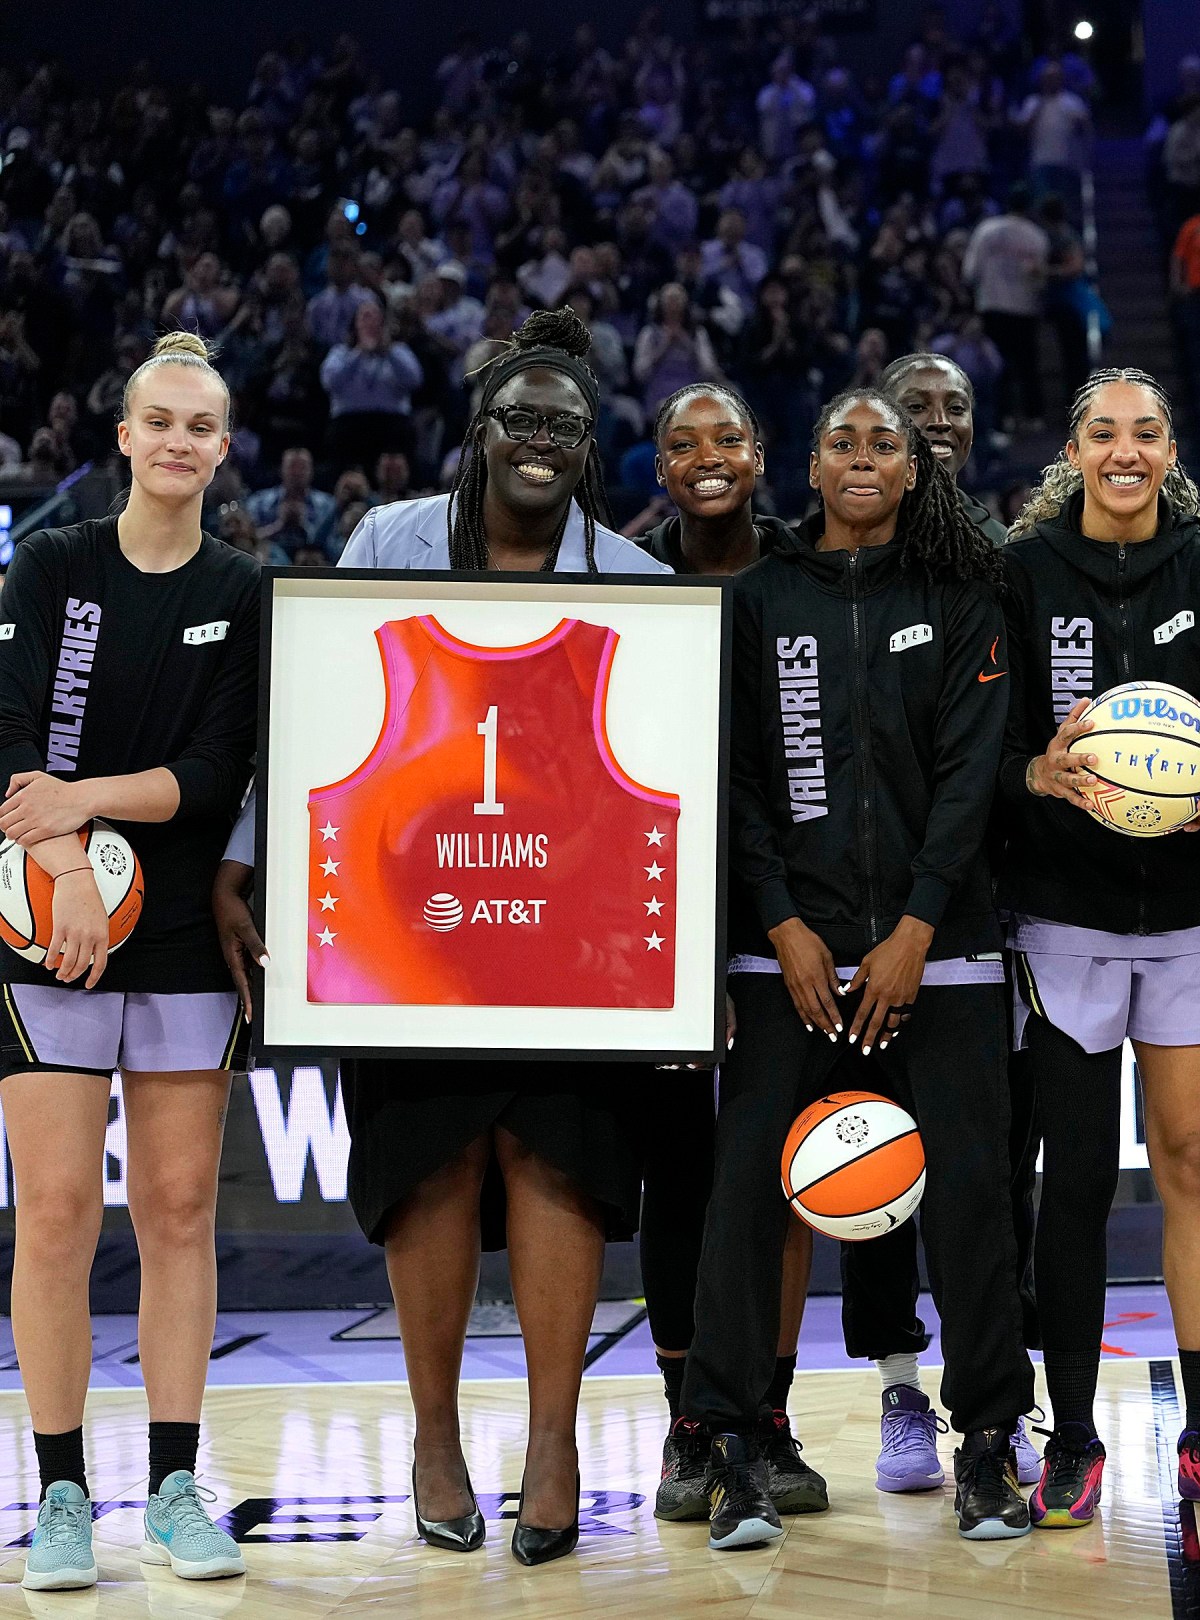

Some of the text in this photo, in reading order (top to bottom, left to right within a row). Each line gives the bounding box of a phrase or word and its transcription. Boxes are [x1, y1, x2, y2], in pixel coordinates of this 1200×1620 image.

[890, 627, 929, 649] IREN
[1157, 613, 1193, 641] IREN
[46, 597, 102, 772] VALKYRIES
[776, 635, 829, 824] VALKYRIES
[473, 705, 504, 815] 1
[436, 833, 548, 868] WILLIAMS
[470, 899, 547, 924] AT&T
